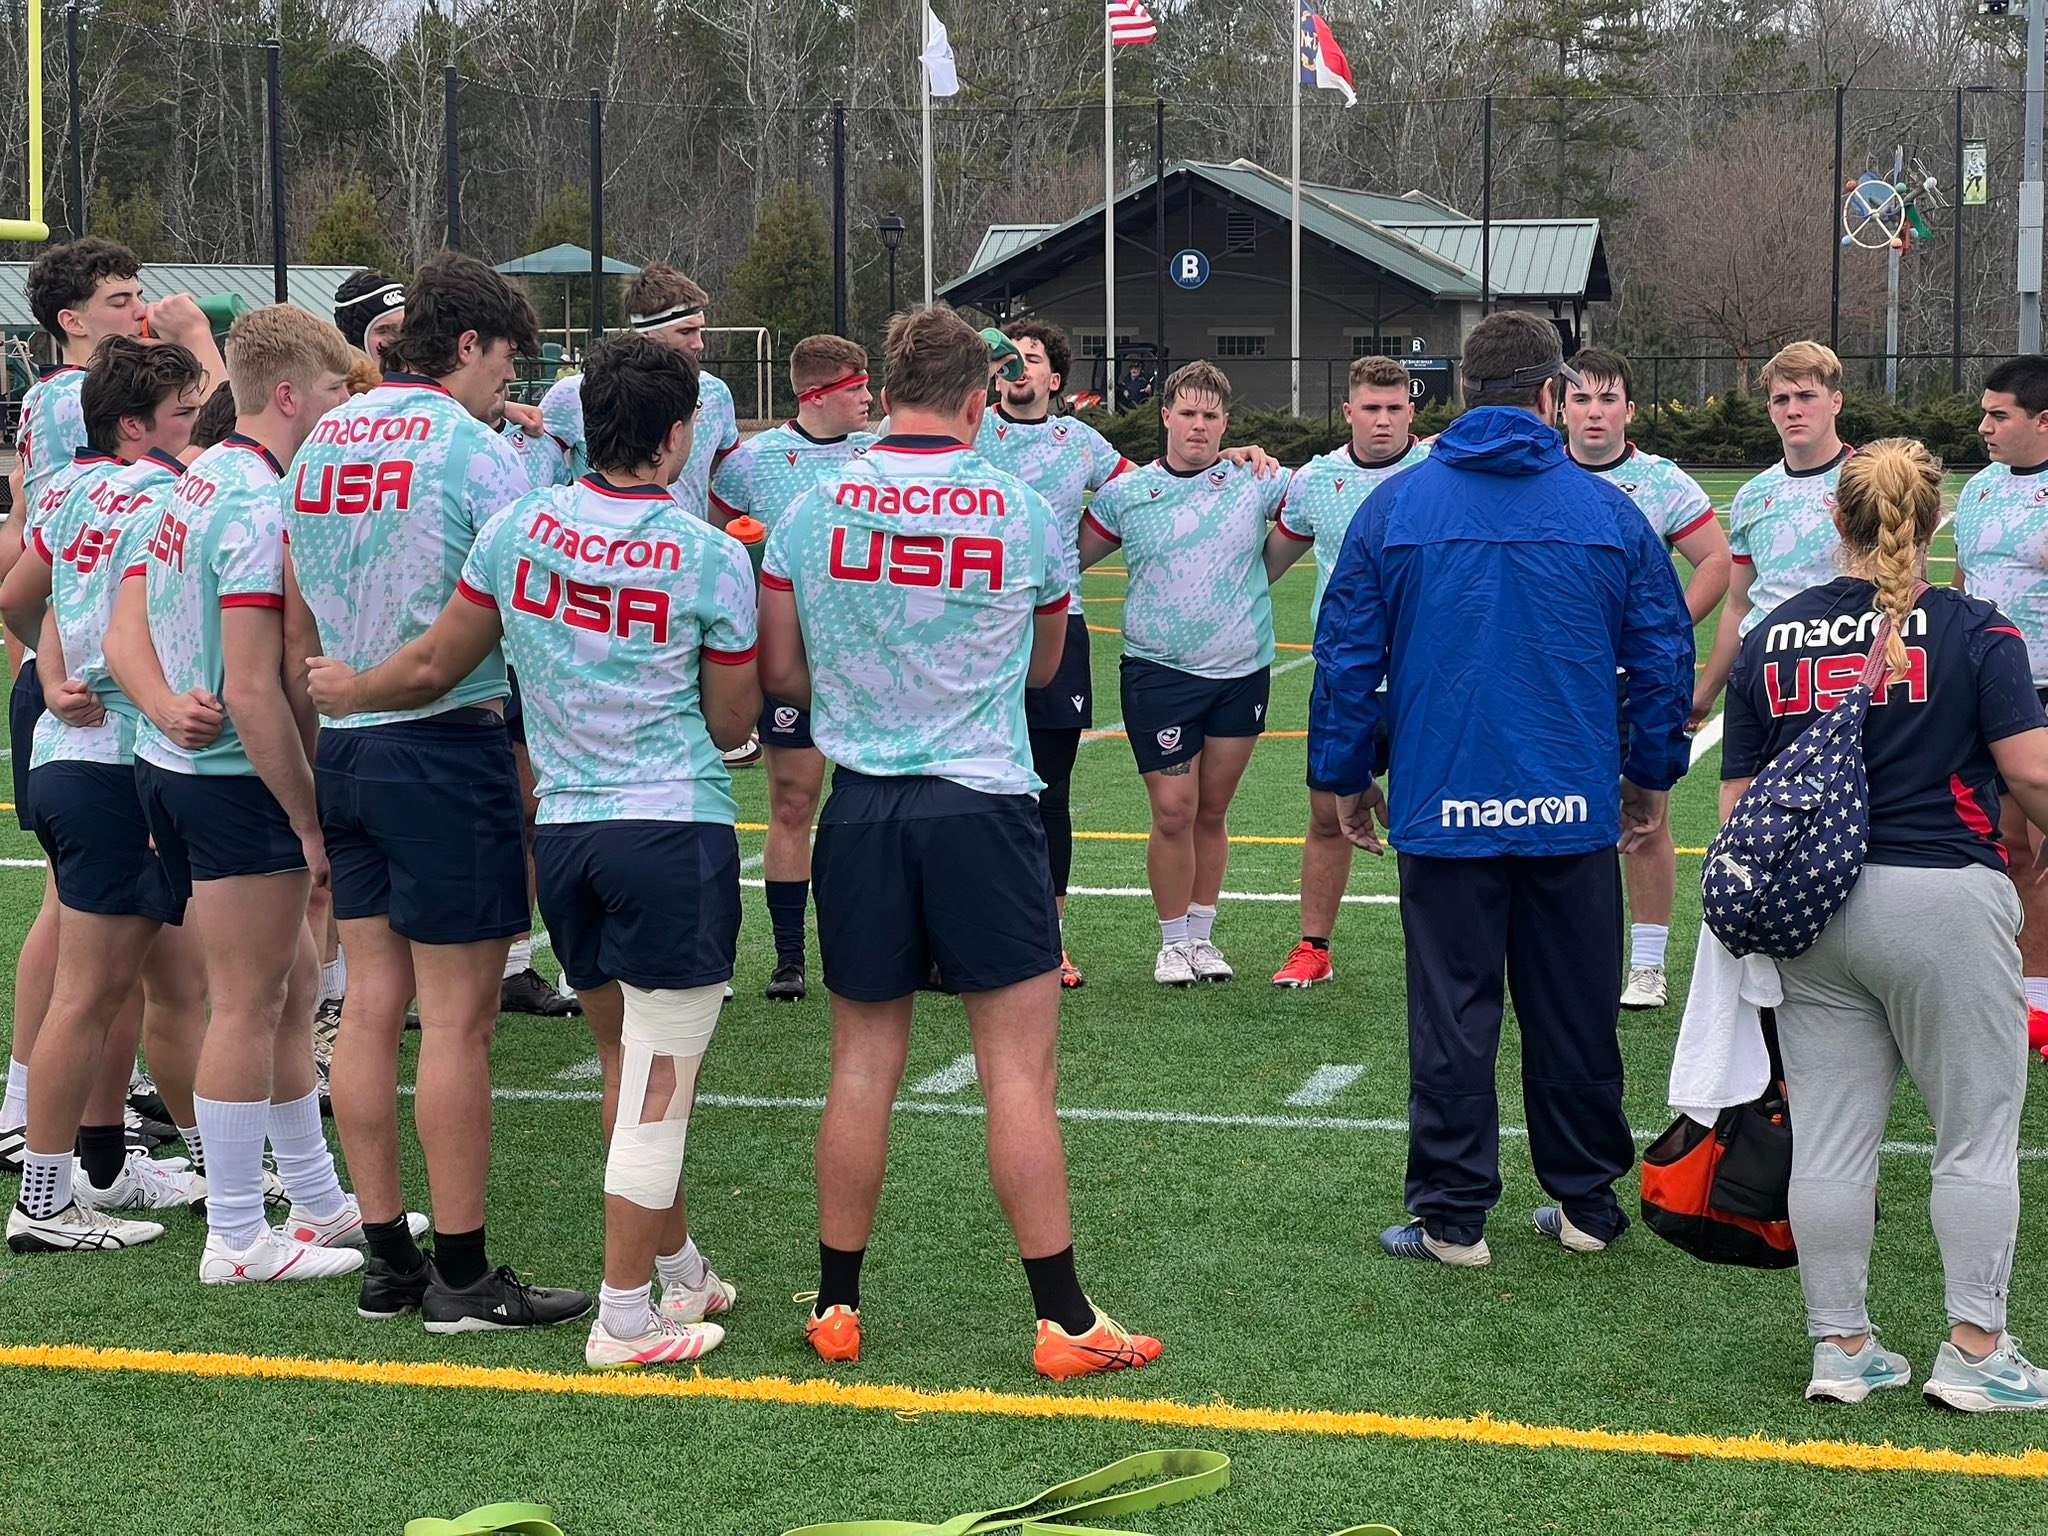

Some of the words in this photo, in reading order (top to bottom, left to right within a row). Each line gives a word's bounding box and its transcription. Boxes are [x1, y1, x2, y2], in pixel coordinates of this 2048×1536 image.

[1182, 254, 1199, 279] B
[1412, 339, 1421, 351] B
[309, 415, 432, 446] macron
[294, 459, 415, 516] USA
[835, 482, 1006, 518] macron
[527, 512, 682, 571] macron
[828, 526, 1005, 593] USA
[510, 557, 672, 645] USA
[1765, 606, 1928, 653] macrn
[1441, 795, 1588, 828] macron
